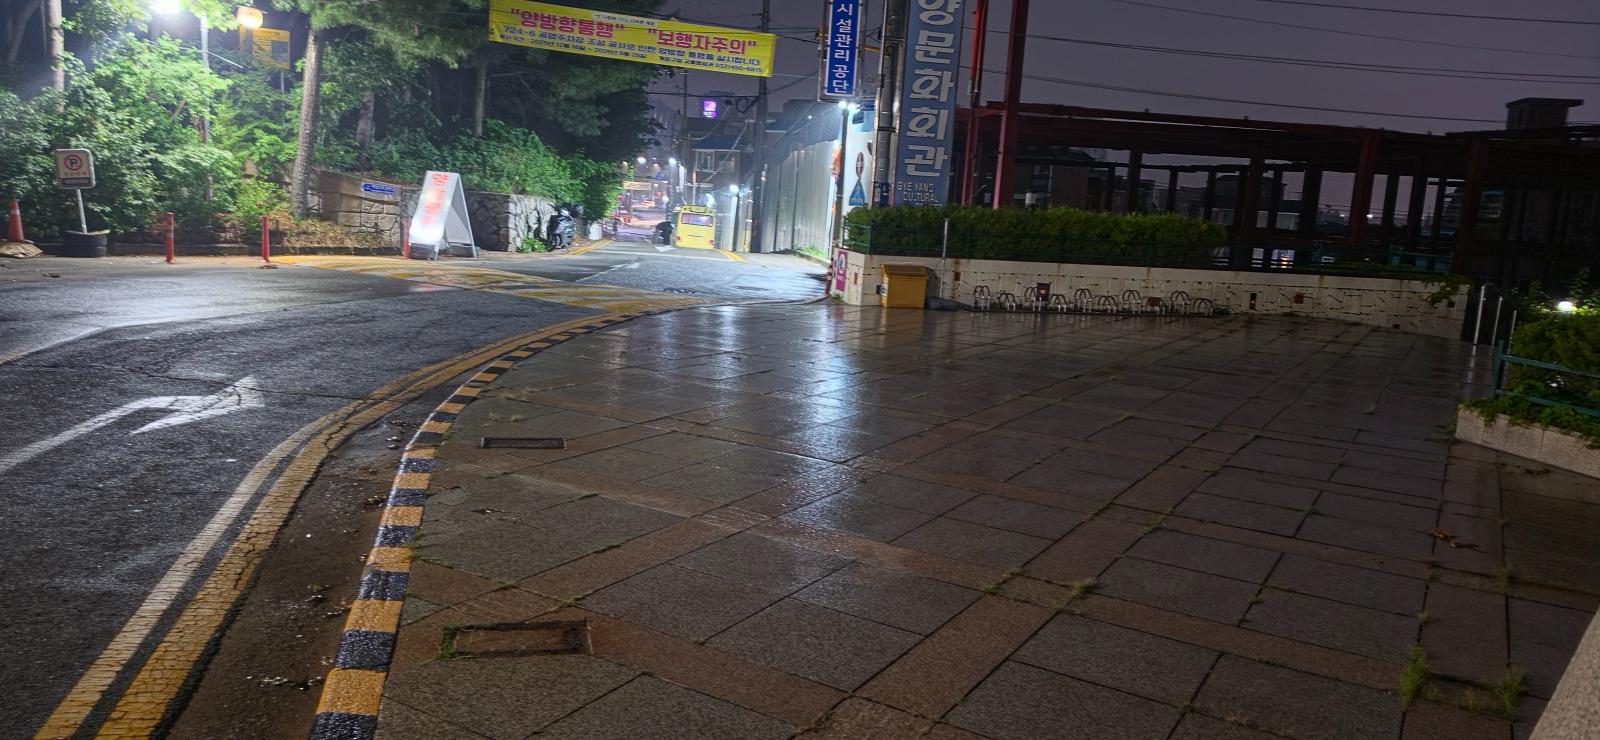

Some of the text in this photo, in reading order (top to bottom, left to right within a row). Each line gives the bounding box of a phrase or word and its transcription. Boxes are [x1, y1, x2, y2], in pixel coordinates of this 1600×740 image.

[504, 26, 535, 37] 724-6
[717, 54, 760, 66] 실시합니다
[832, 3, 852, 95] 시설관리공단
[903, 191, 940, 203] CULTURAL
